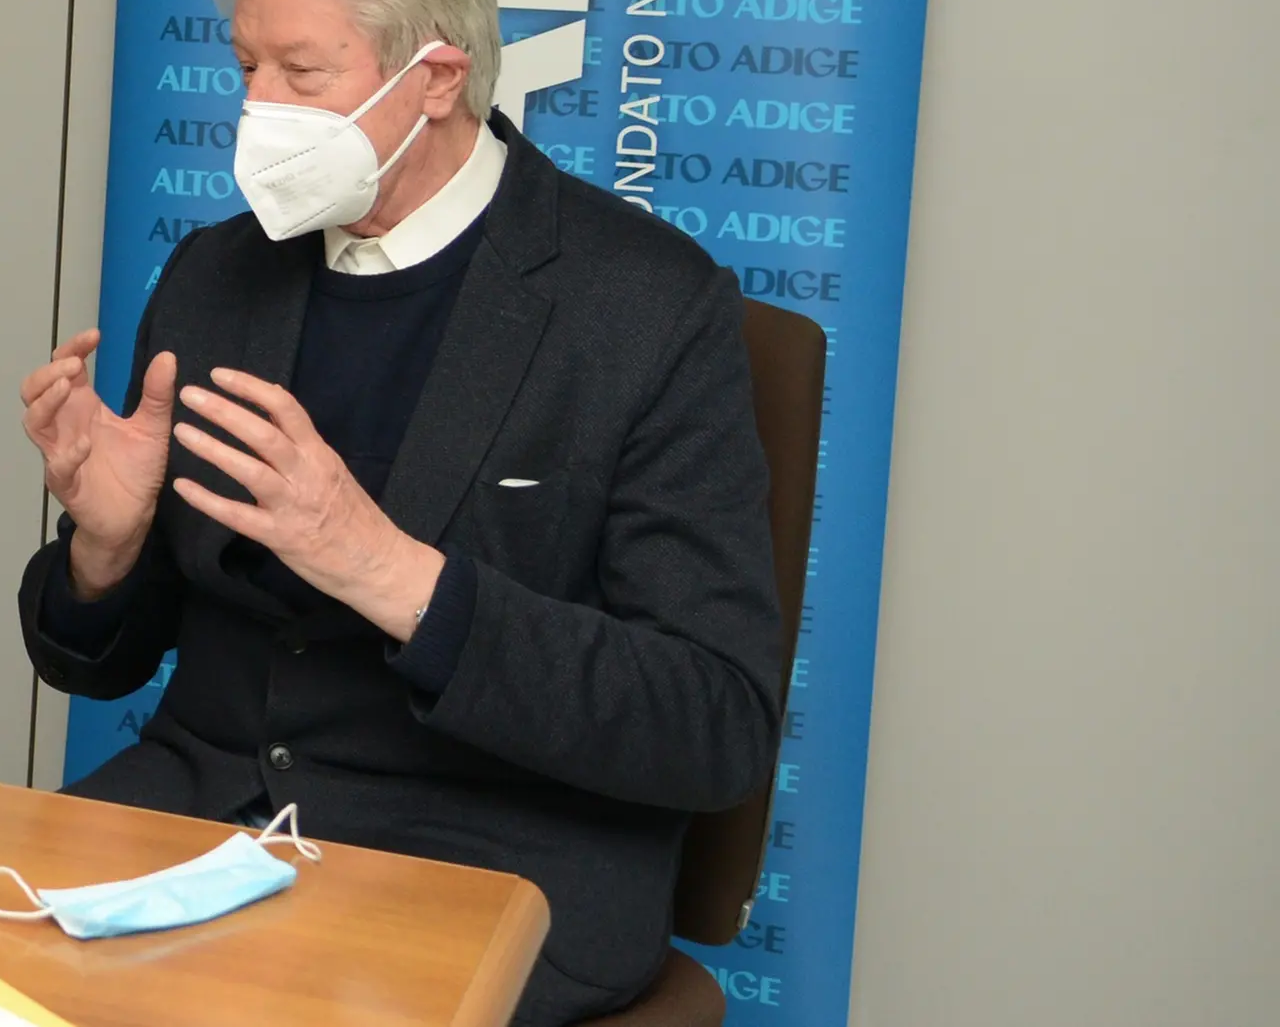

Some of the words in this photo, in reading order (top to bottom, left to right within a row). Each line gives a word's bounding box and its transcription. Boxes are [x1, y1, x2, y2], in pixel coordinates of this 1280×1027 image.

[731, 45, 859, 79] ADIGE
[156, 65, 240, 96] ALTO
[726, 98, 855, 134] ADIGE
[150, 168, 234, 200] ALTO
[722, 157, 850, 193] ADIGE
[717, 210, 846, 248] ADIGE
